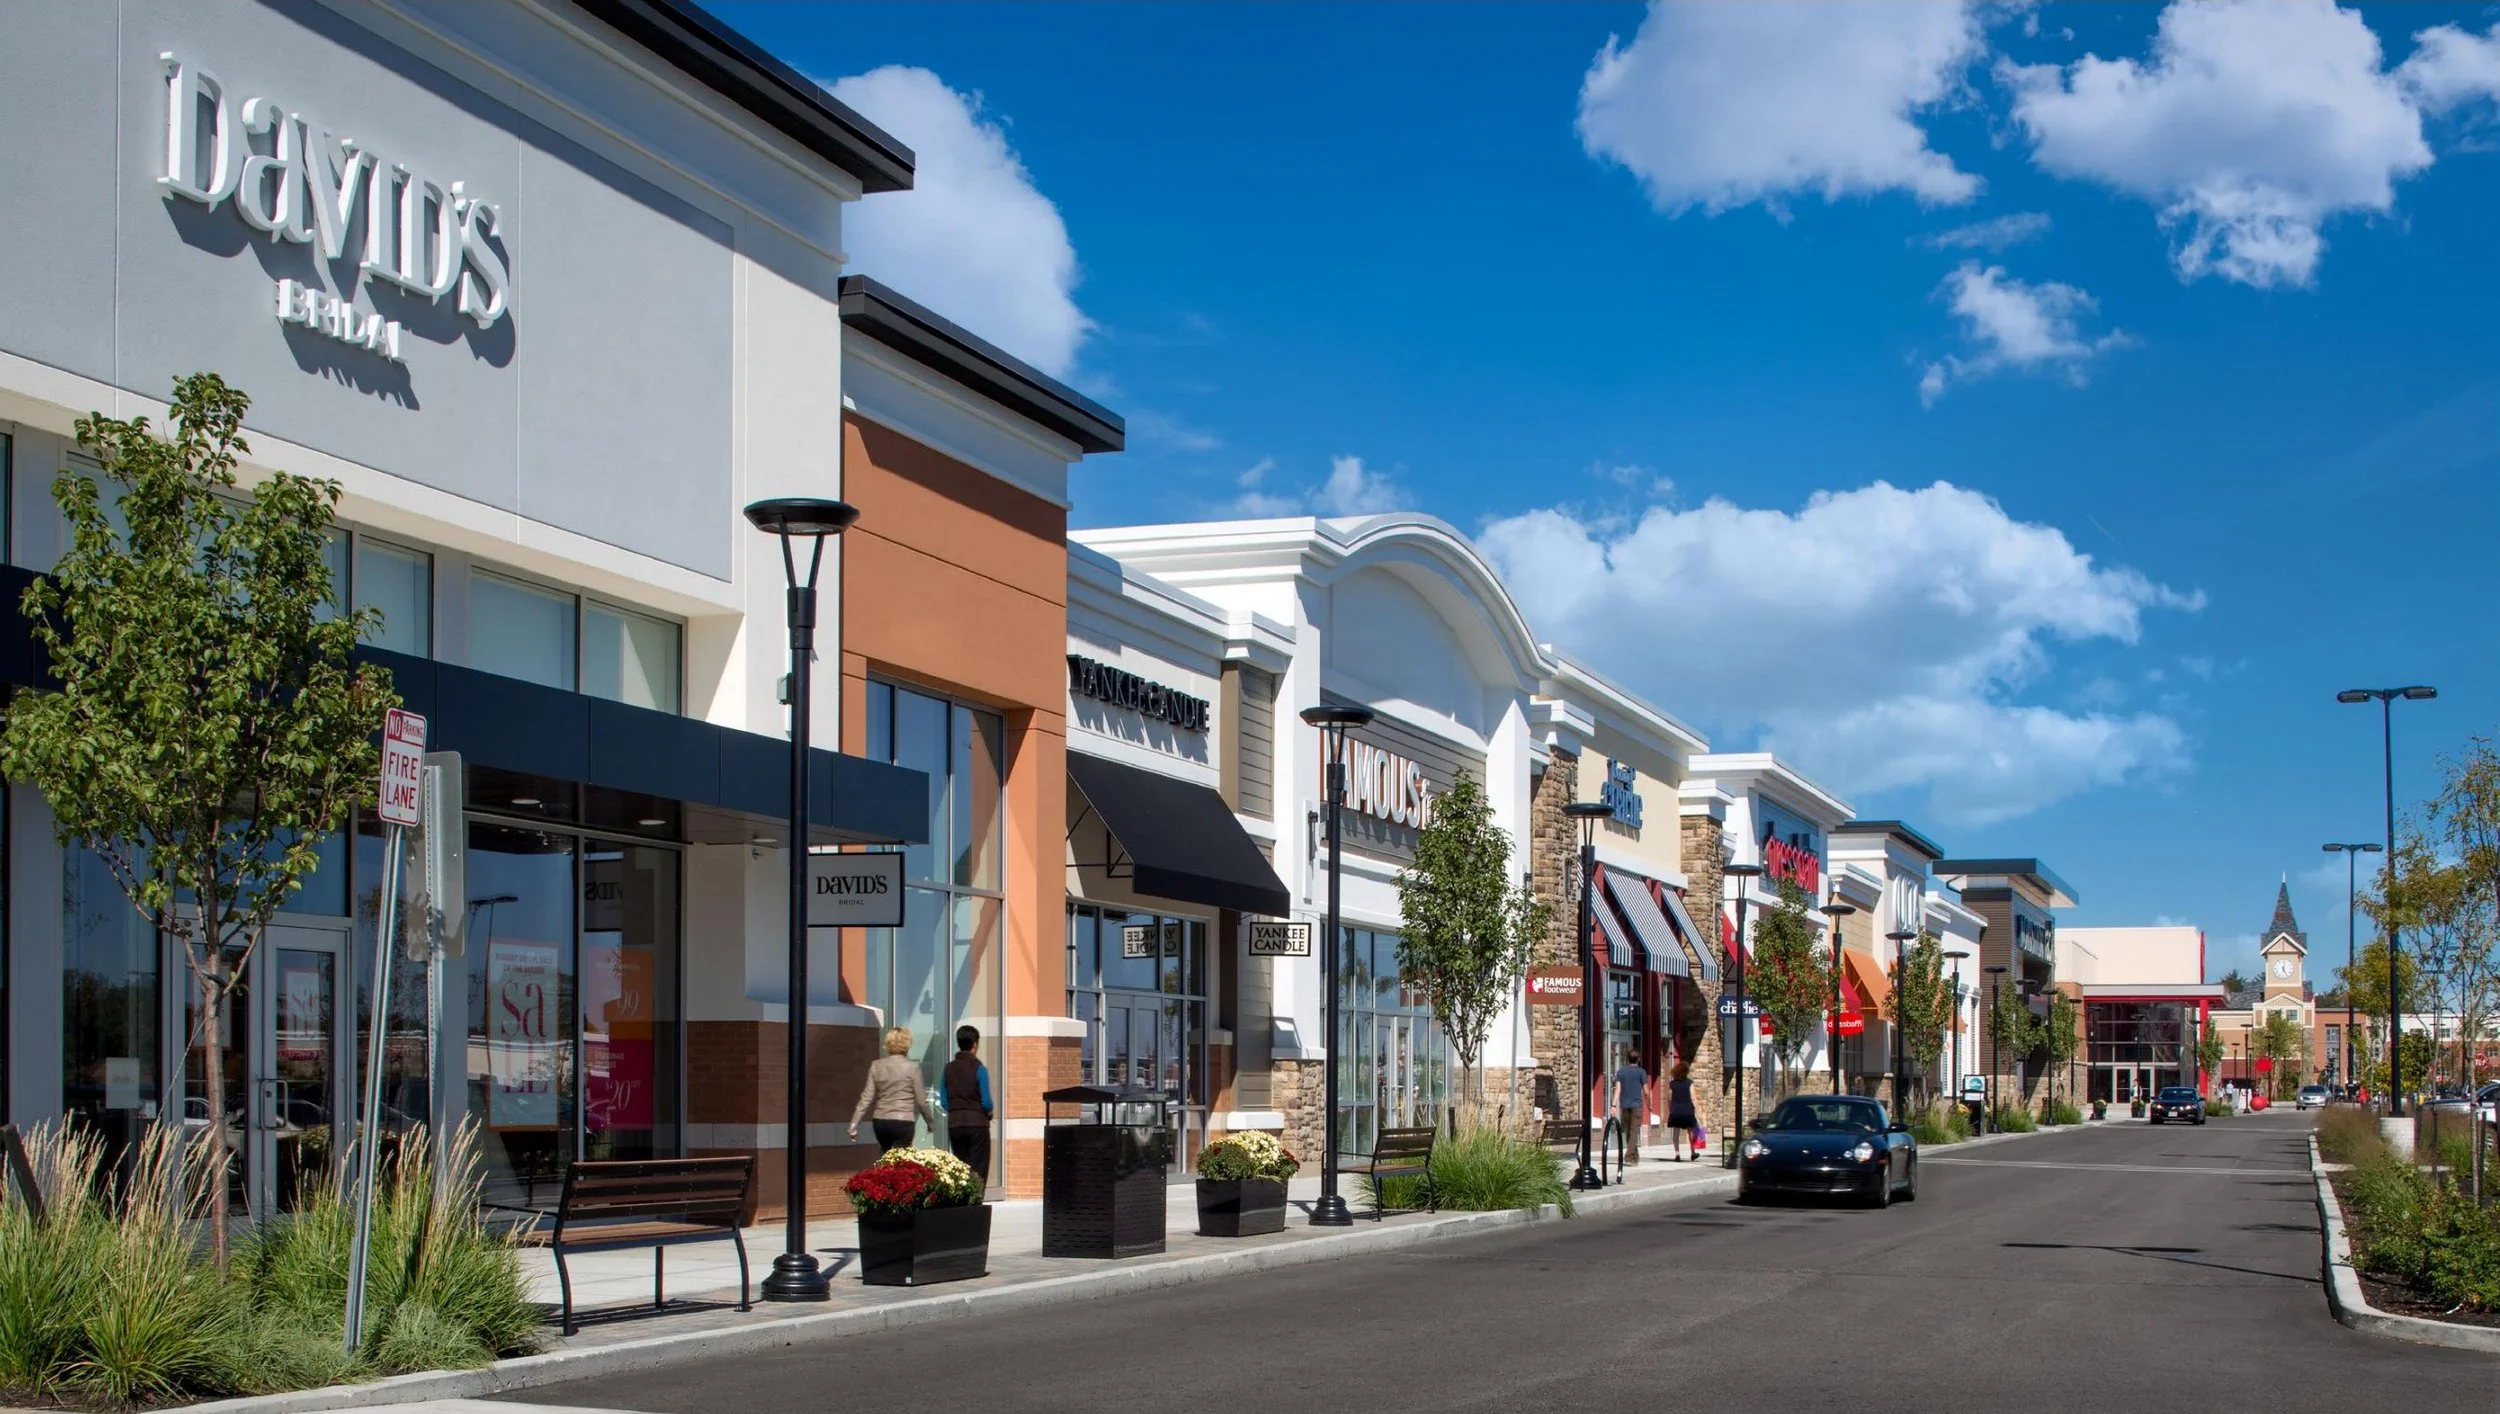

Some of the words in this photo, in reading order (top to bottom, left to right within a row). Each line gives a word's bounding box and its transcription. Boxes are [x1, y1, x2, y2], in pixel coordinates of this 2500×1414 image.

[389, 714, 401, 737] NO
[388, 751, 419, 781] FIRE
[385, 781, 417, 810] LANE
[1255, 927, 1305, 940] YANKEE
[1254, 939, 1305, 952] CANDLE
[1544, 977, 1582, 987] FAMOUS
[1544, 986, 1578, 994] footwear
[1827, 1020, 1863, 1028] dssbarn
